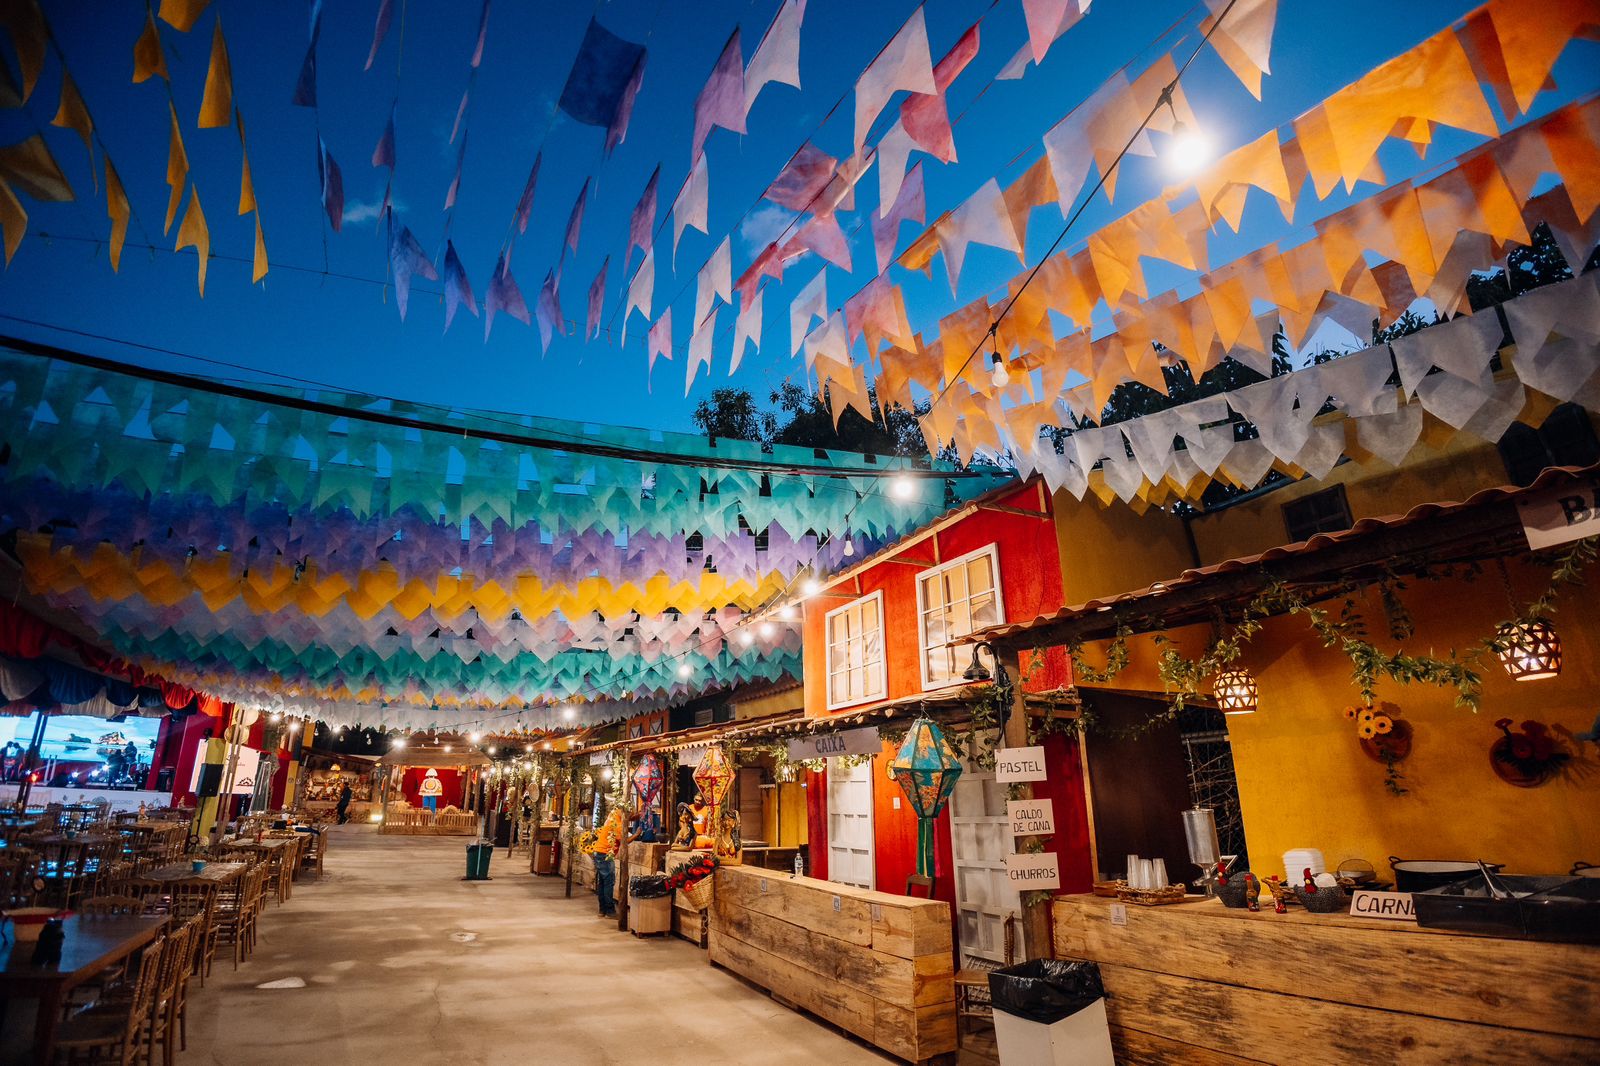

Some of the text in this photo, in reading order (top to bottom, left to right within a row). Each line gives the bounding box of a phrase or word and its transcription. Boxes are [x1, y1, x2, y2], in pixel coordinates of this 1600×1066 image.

[816, 736, 846, 753] CAIXA
[1000, 761, 1042, 774] PASTEL
[1015, 809, 1043, 820] CALDO
[1014, 821, 1051, 833] DE CANA
[1010, 868, 1056, 880] CHURROS
